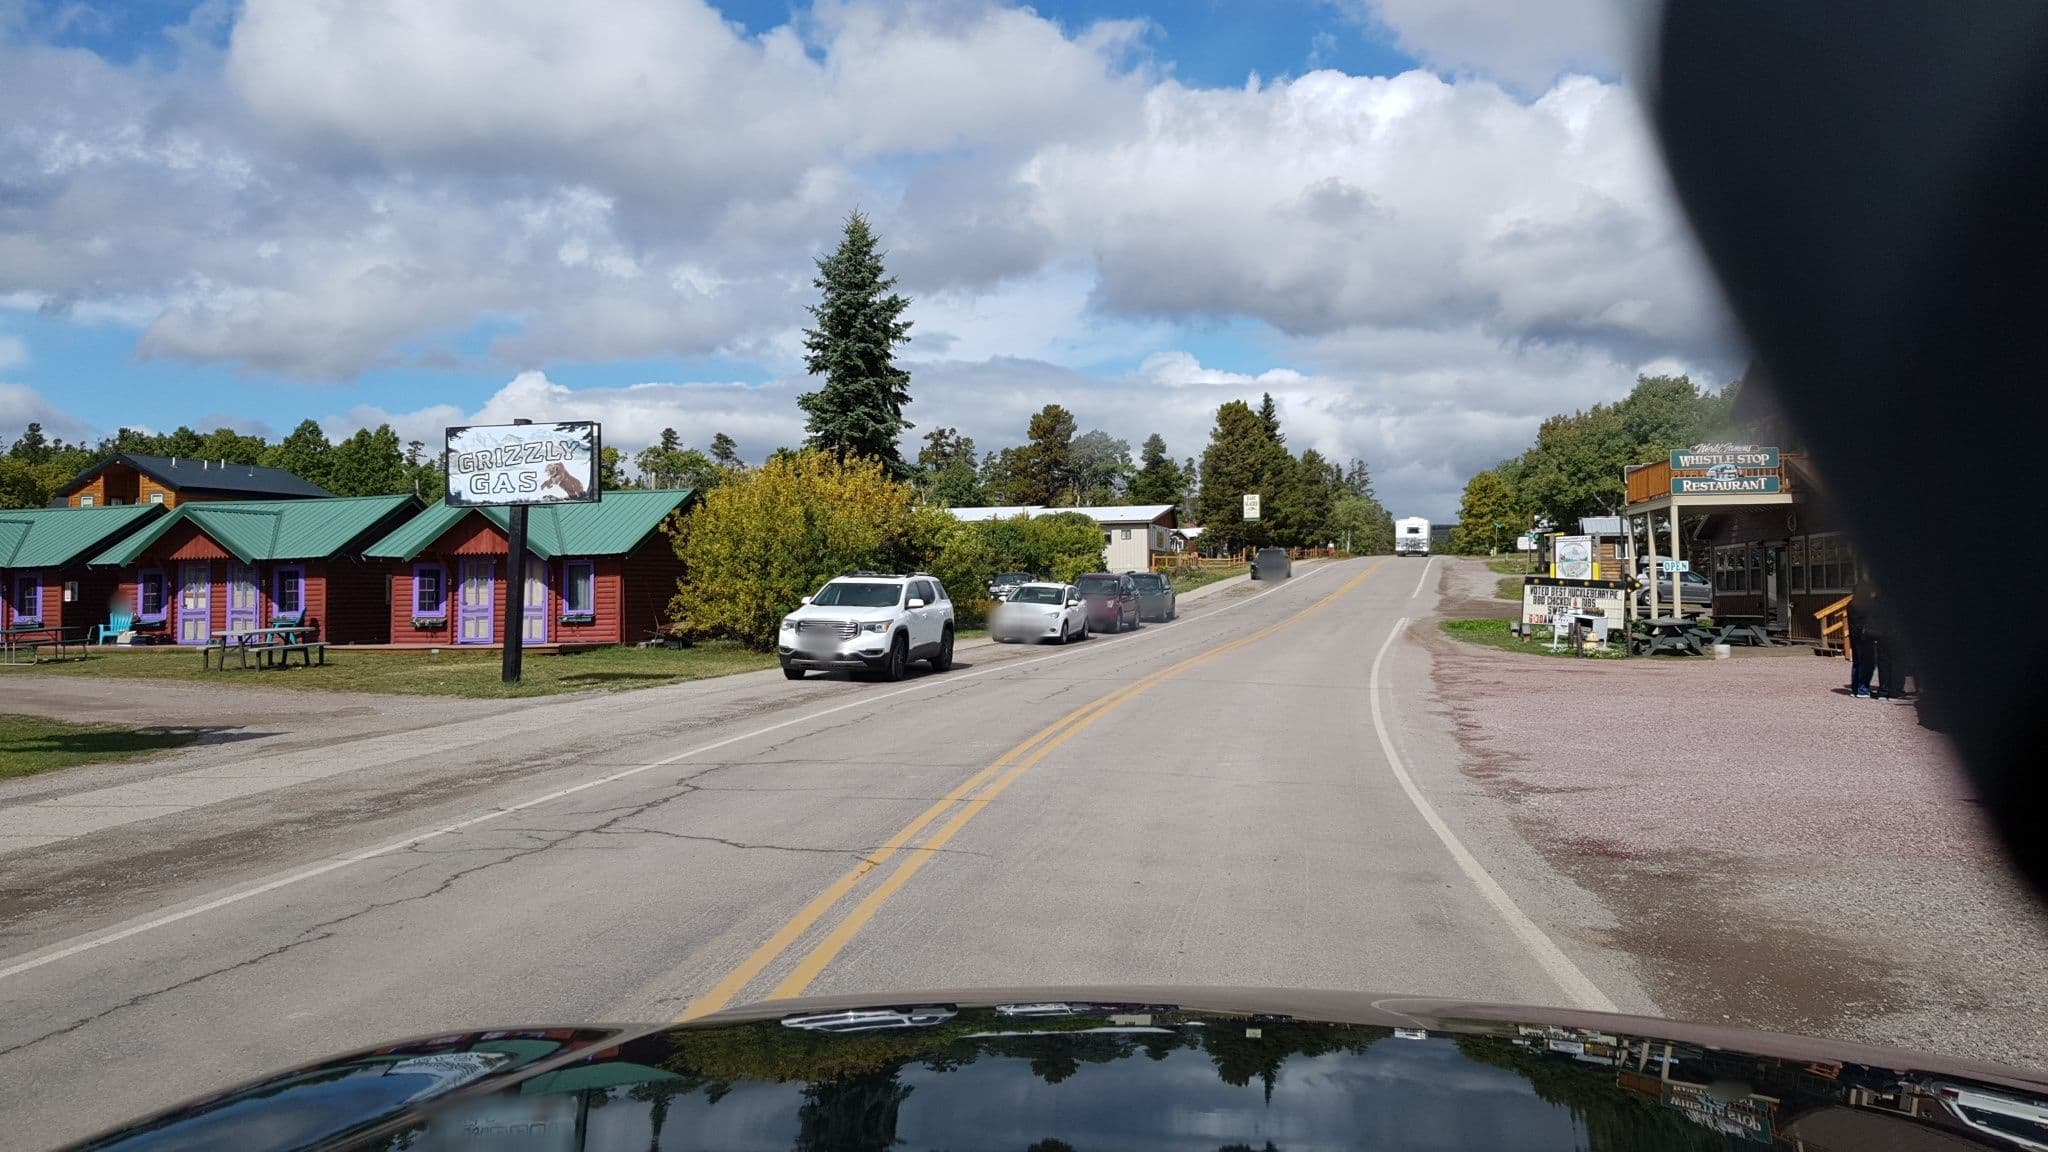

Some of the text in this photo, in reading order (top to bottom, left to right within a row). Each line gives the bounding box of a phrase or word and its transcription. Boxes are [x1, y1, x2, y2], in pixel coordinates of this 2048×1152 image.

[1695, 443, 1752, 454] World Famous
[458, 441, 579, 474] GRIZZLY
[1679, 454, 1770, 467] WHISTLE STOP
[470, 471, 537, 495] GAS
[1683, 478, 1767, 491] RESTAURANT
[1664, 562, 1687, 571] OPEN
[1530, 587, 1549, 596] VOTED
[1551, 587, 1567, 597] BEST
[1568, 588, 1608, 599] HUCKLEBERRY
[1547, 596, 1571, 606] CHICKEN
[1582, 598, 1596, 608] RIBS
